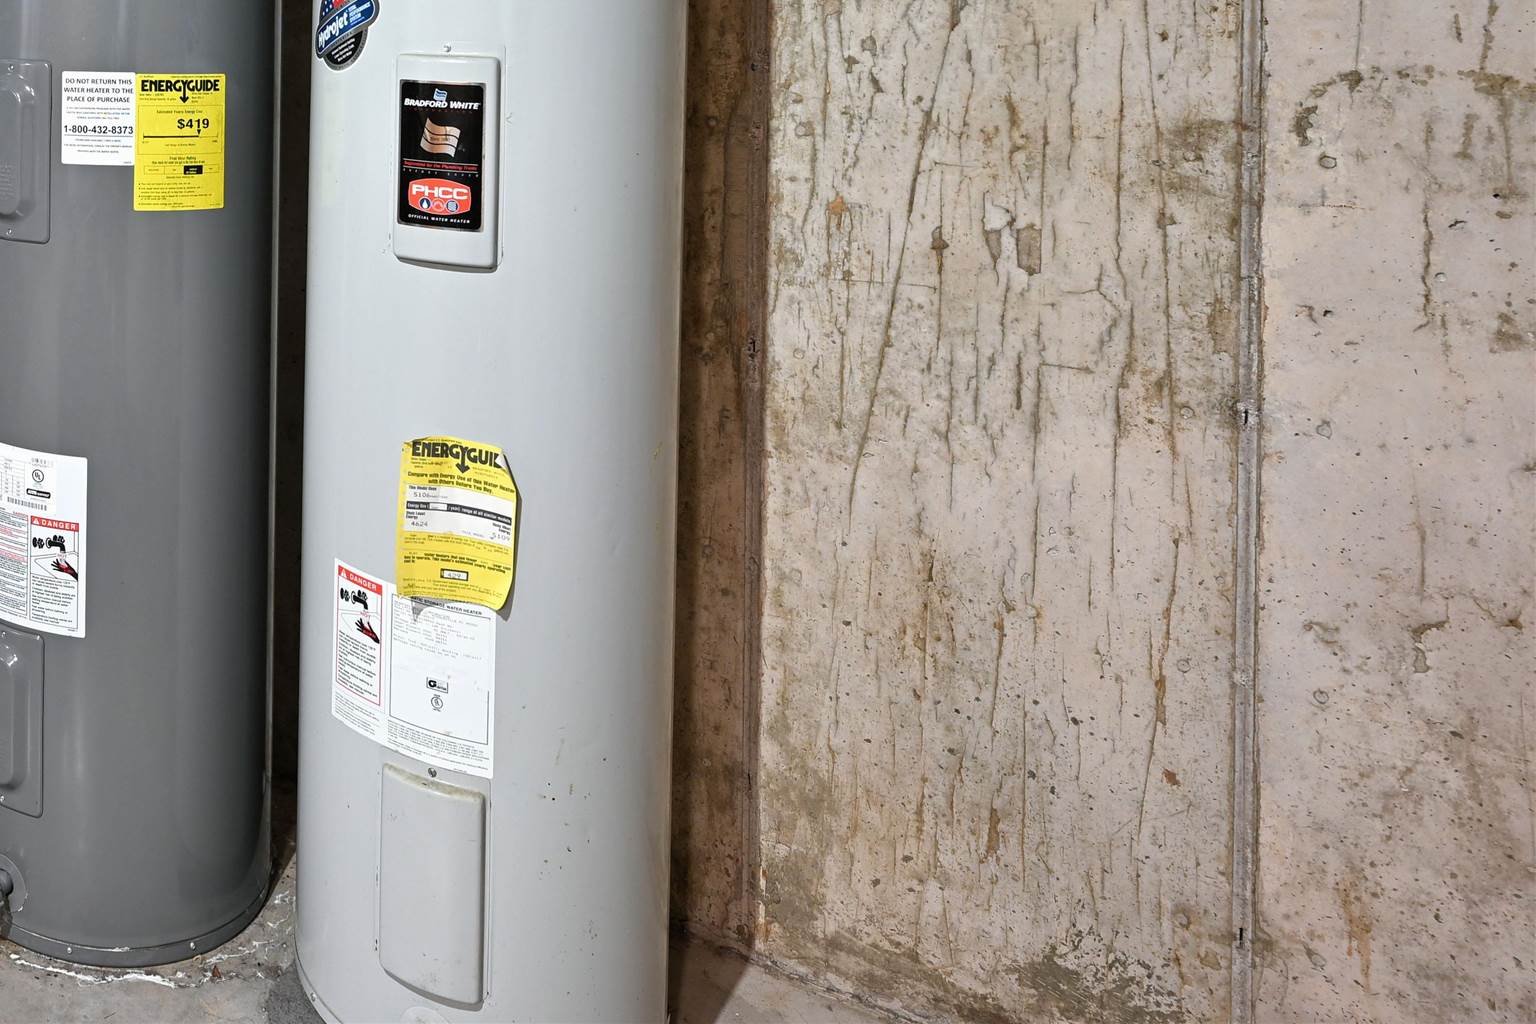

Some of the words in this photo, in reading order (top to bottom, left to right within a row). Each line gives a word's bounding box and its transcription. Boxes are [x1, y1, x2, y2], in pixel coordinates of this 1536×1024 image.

[318, 12, 348, 48] Hydrojet
[141, 79, 220, 96] ENERGYGUIDE
[404, 98, 448, 108] BRADFORD
[450, 101, 479, 110] WHITE
[64, 125, 134, 134] 1-800-432-8373
[177, 118, 209, 129] $419
[412, 184, 468, 200] PHCC
[42, 520, 76, 530] DANGER
[350, 574, 377, 590] DANGER
